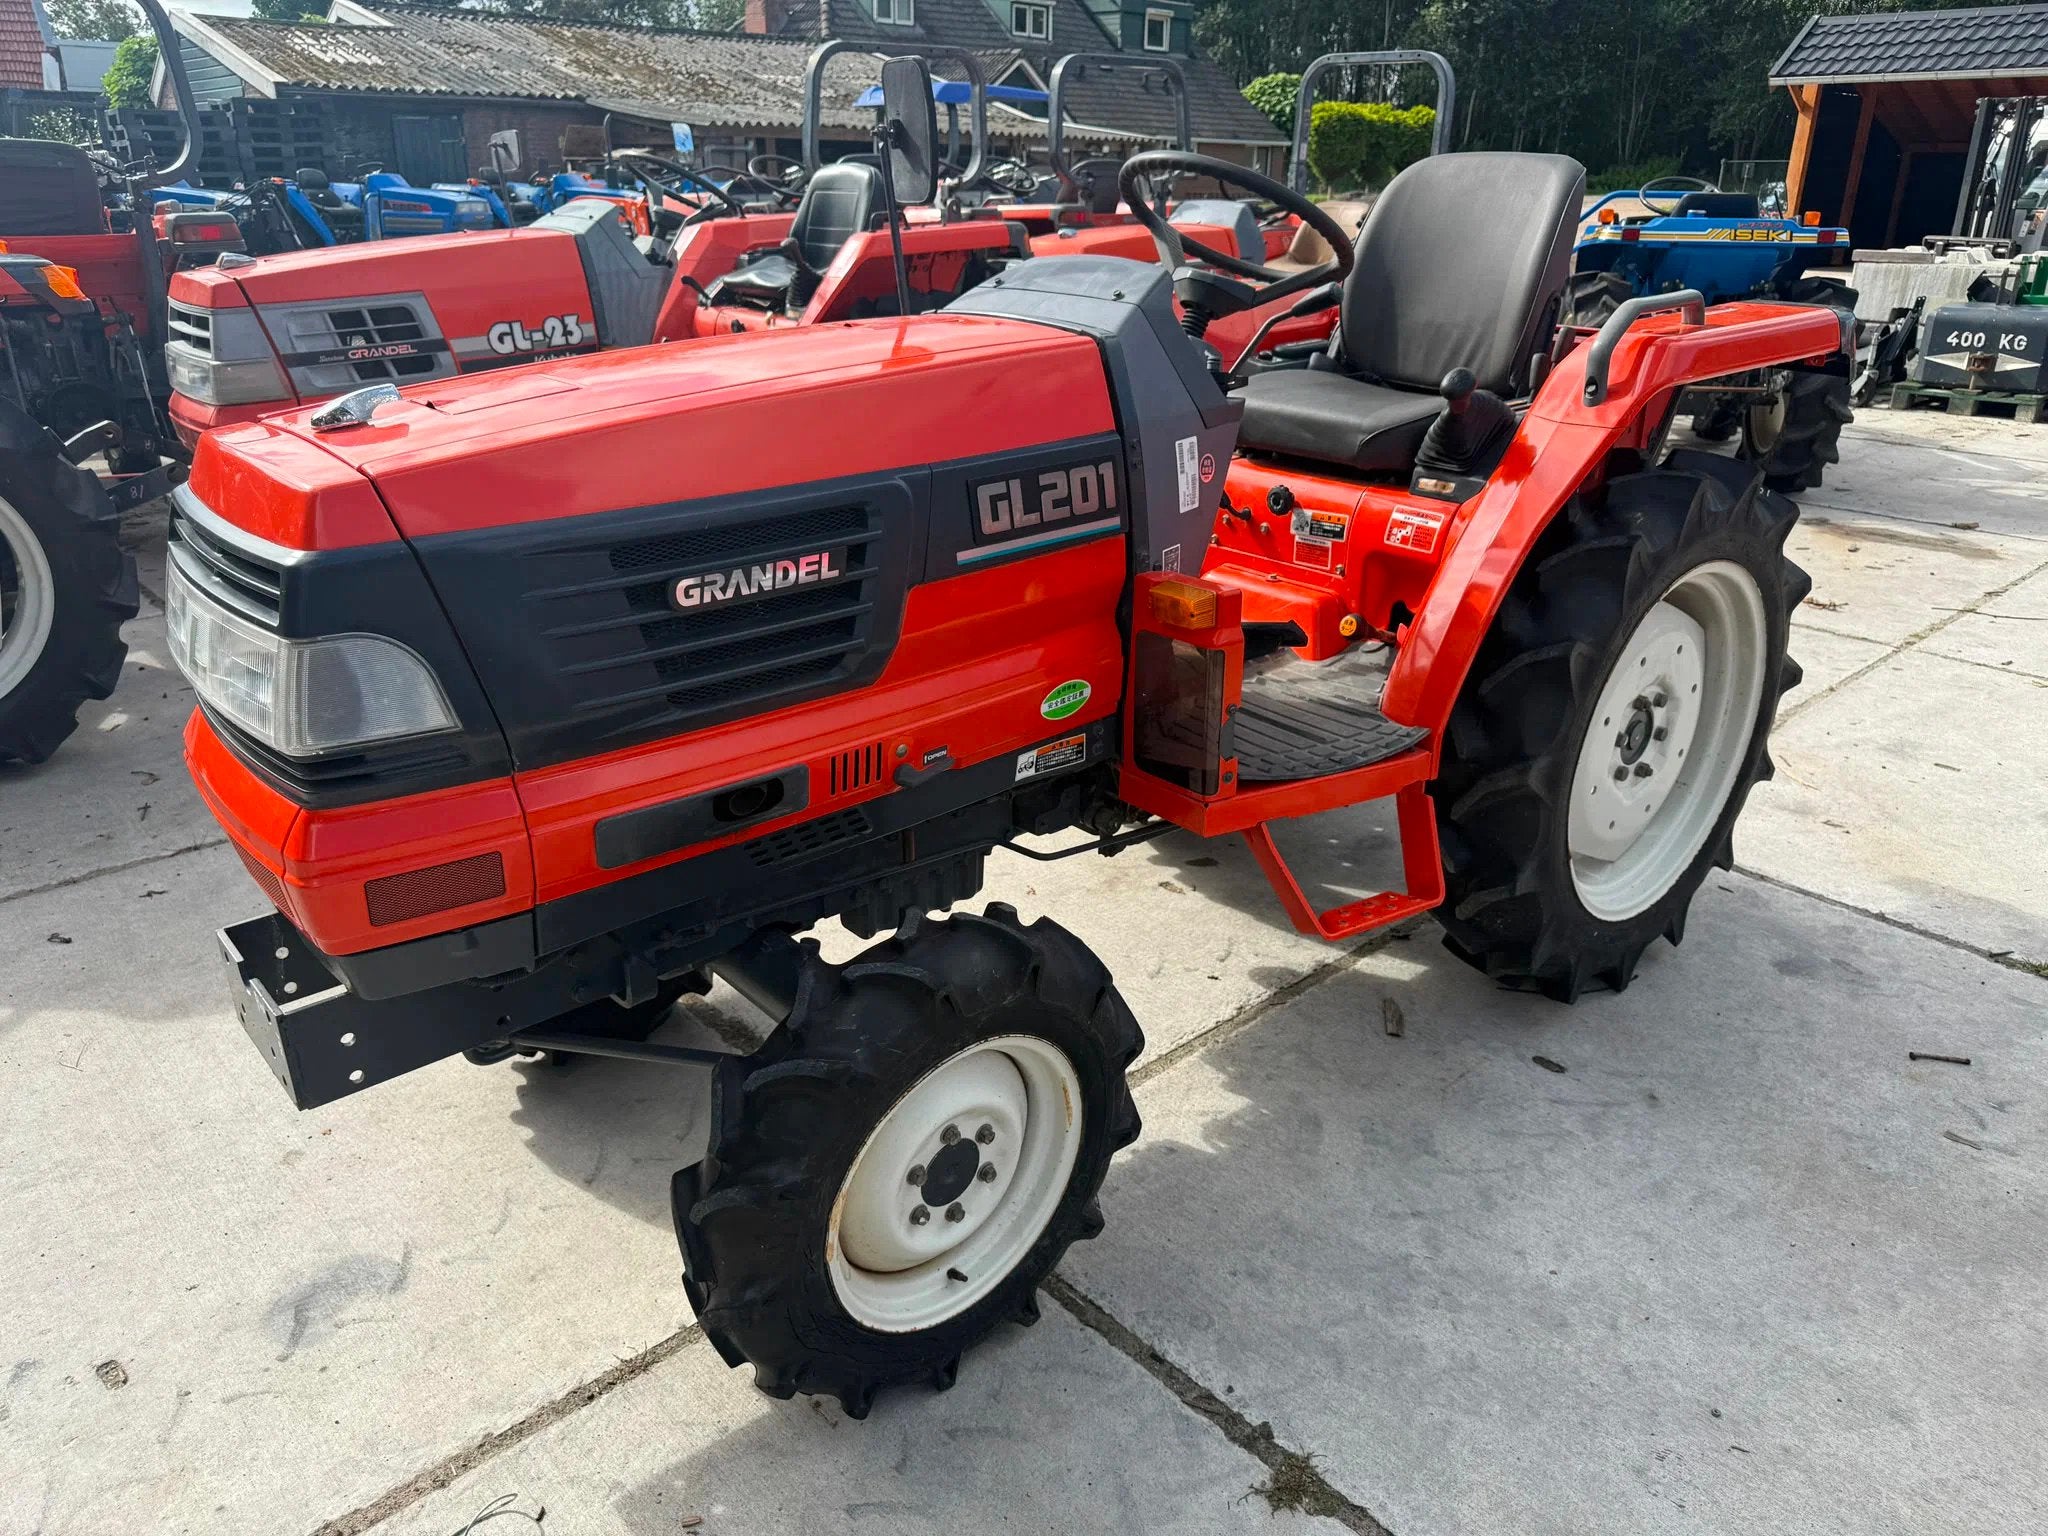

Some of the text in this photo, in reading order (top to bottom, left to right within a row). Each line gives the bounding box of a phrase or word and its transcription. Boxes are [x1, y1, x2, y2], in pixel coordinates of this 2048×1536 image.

[1730, 229, 1792, 241] ISEKI
[488, 314, 583, 354] GL-23
[1946, 330, 2028, 351] 400 KG
[348, 344, 418, 359] GRANDEL
[976, 461, 1117, 535] GL201
[675, 552, 840, 608] GRANDEL
[927, 750, 948, 761] OPEN
